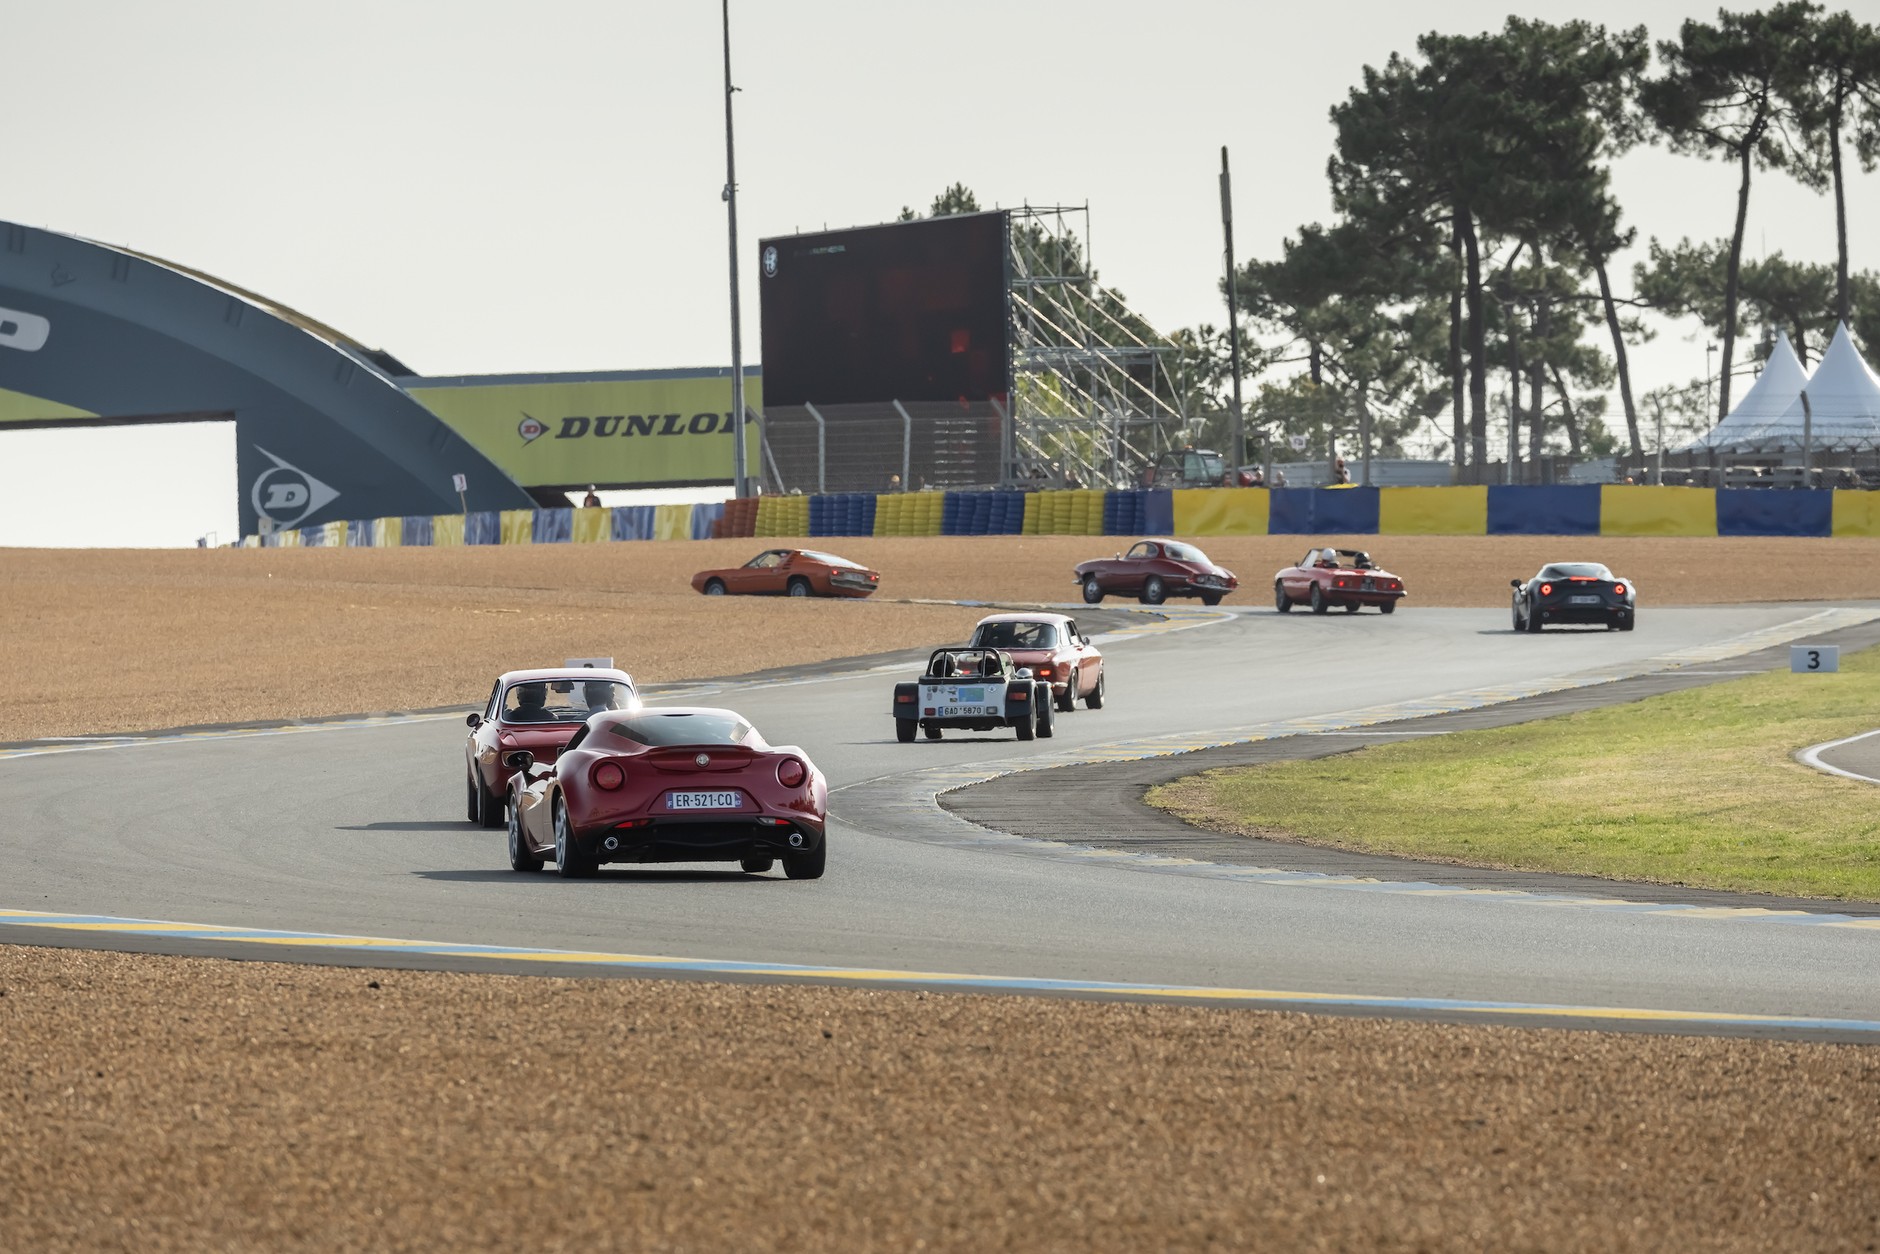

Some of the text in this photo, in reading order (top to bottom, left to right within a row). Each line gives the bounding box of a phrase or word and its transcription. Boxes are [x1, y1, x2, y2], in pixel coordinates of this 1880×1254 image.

[263, 483, 309, 509] D
[1807, 650, 1821, 670] 3
[963, 706, 982, 714] 5870
[676, 793, 733, 807] ER-521-CQ
